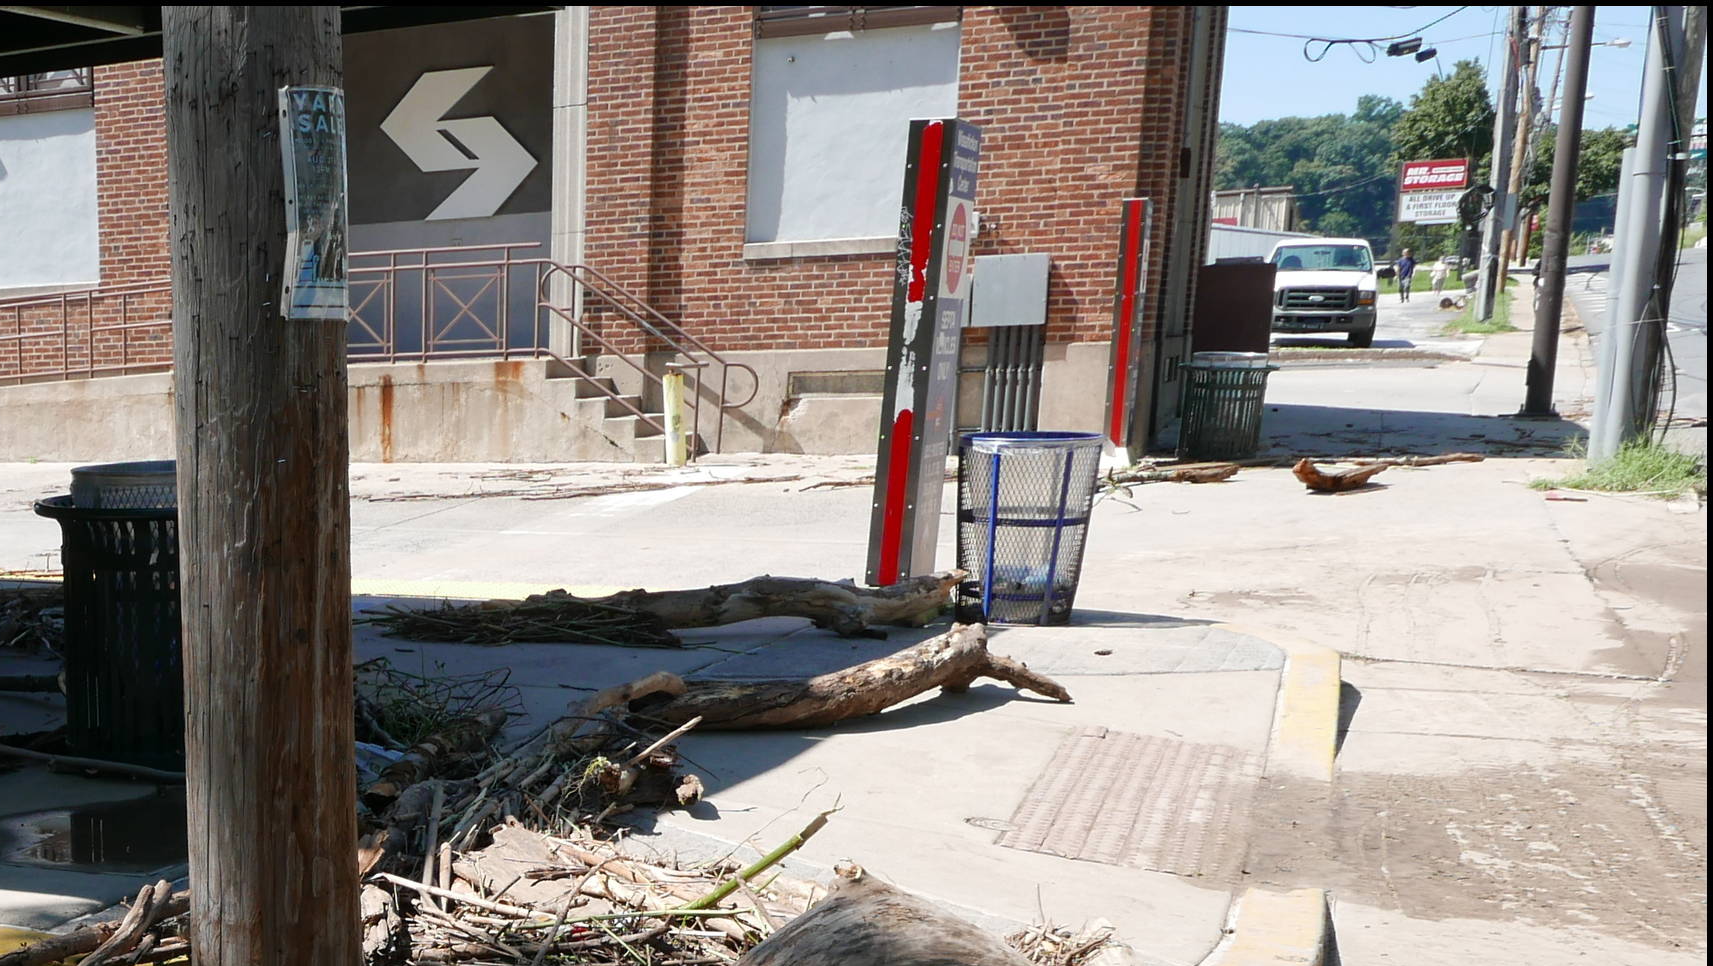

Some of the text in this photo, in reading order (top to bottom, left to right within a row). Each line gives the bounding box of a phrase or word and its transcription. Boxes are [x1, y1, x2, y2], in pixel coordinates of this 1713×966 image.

[1406, 167, 1431, 176] MR.
[1404, 173, 1465, 185] STORAGE
[1434, 201, 1458, 209] FLOOR
